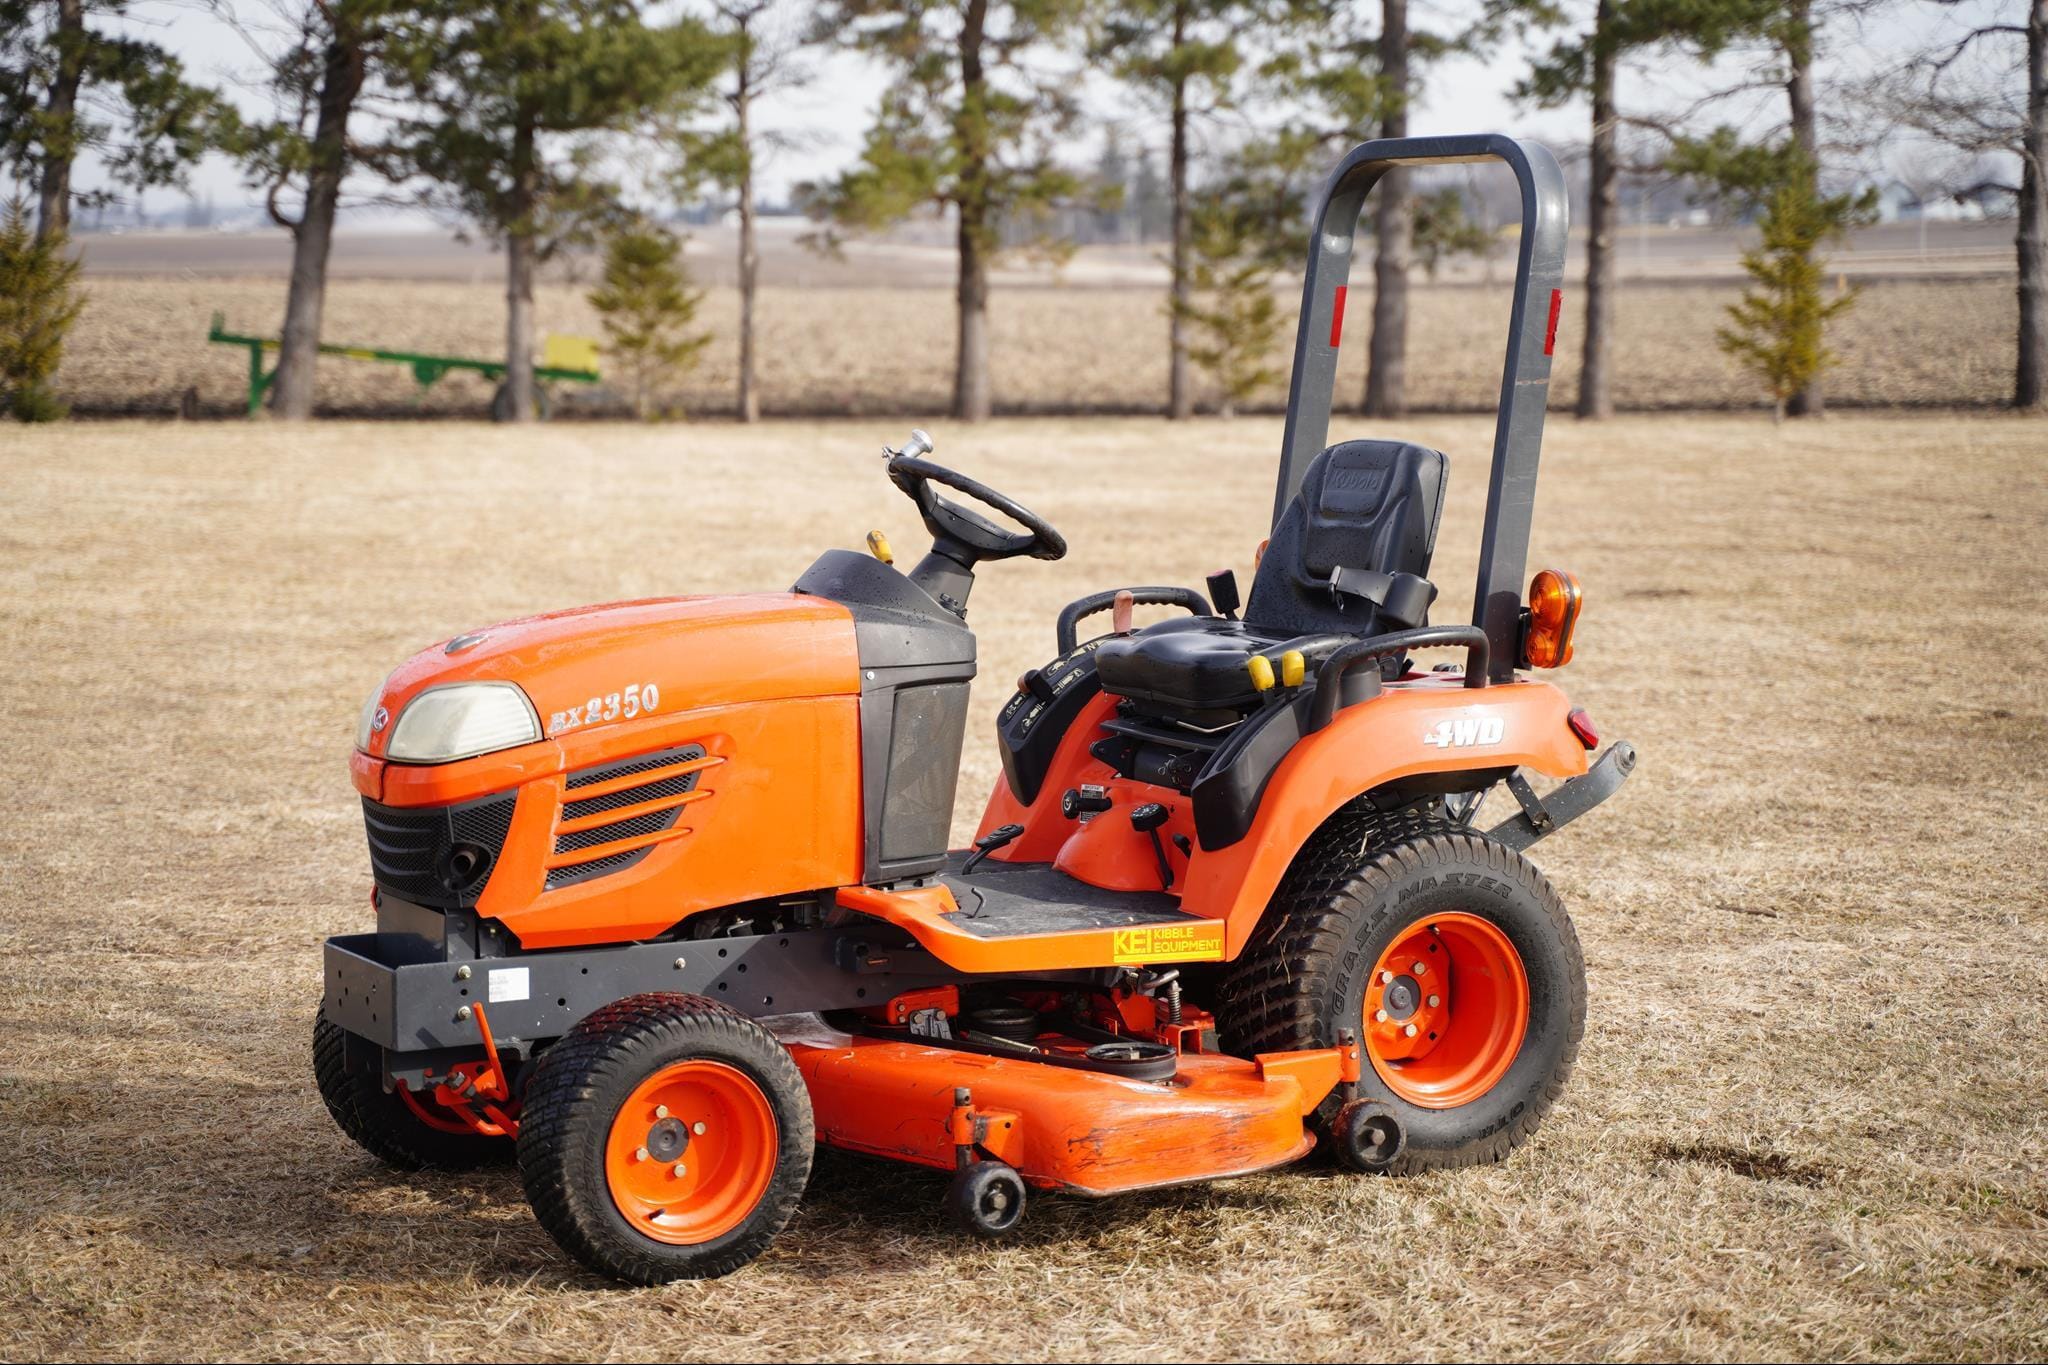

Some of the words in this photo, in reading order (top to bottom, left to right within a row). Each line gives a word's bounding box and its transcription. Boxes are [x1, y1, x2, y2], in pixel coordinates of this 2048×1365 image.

[1423, 717, 1505, 748] 4WD
[1113, 928, 1152, 955] KEI
[1153, 927, 1194, 939] KIBBLE
[1153, 938, 1221, 953] EQUIPMENT
[1331, 903, 1389, 1016] GRASS
[1398, 873, 1513, 905] MASTER
